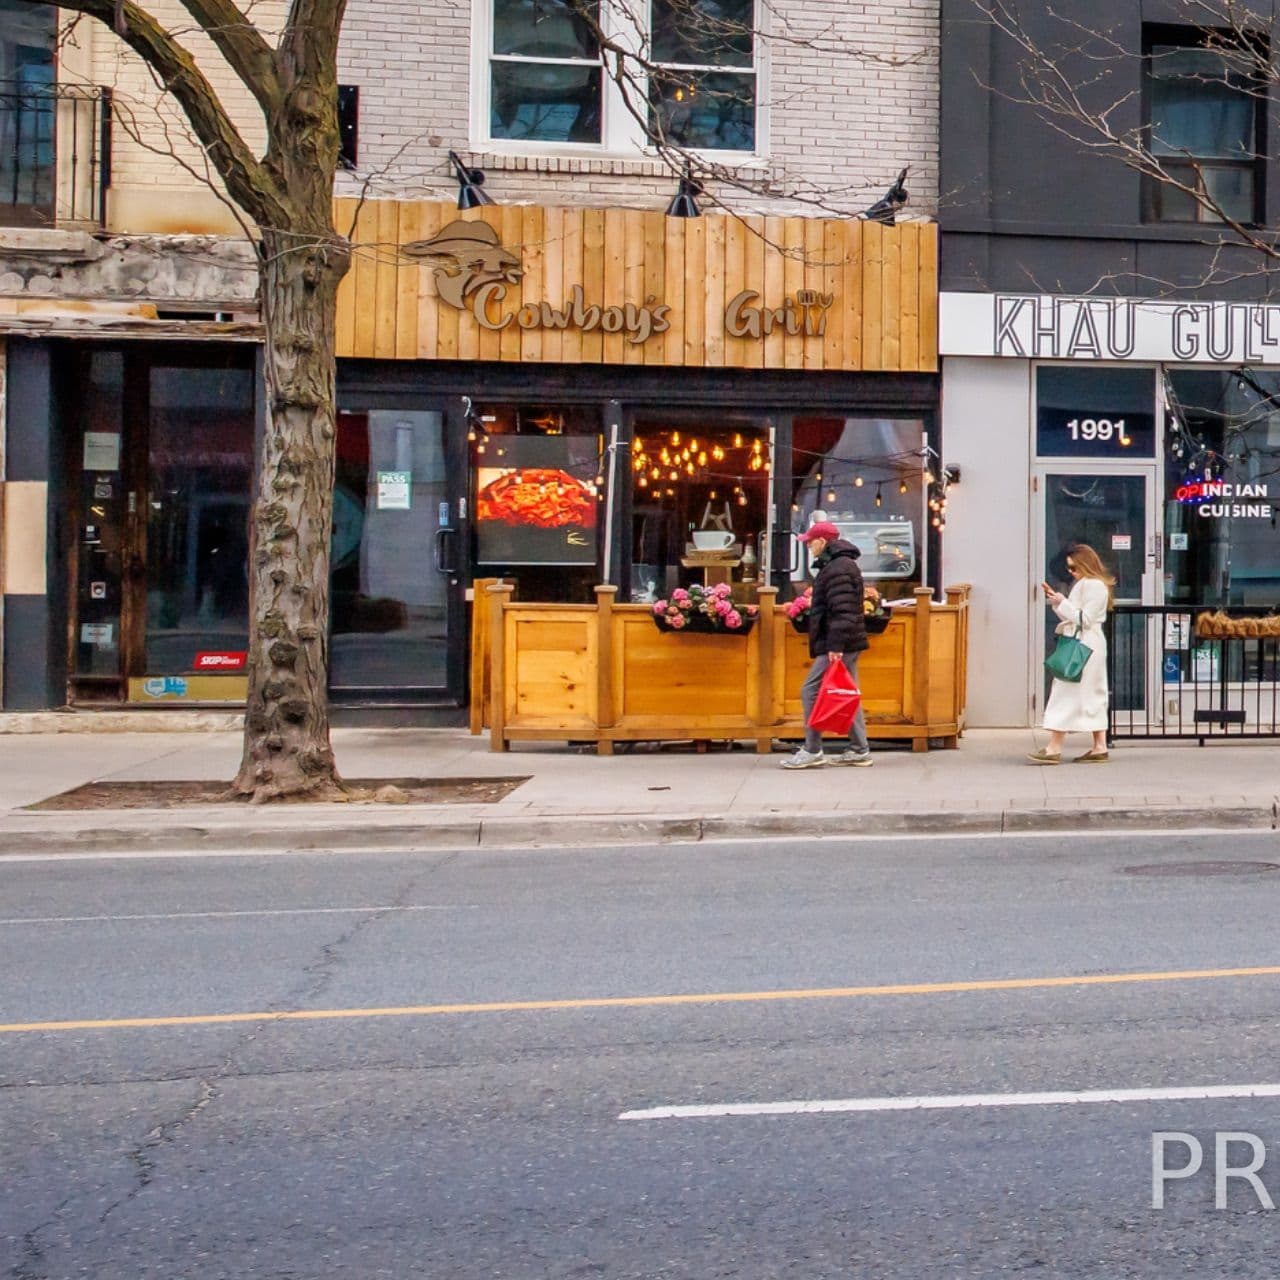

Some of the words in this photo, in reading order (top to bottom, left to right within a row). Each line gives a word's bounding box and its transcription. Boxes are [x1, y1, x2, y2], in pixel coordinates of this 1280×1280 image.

[474, 283, 671, 344] Cowboy's
[994, 294, 1136, 359] KHAU
[1066, 419, 1126, 441] 1991
[1204, 484, 1268, 497] INDIAN
[1199, 504, 1272, 518] CUISINE
